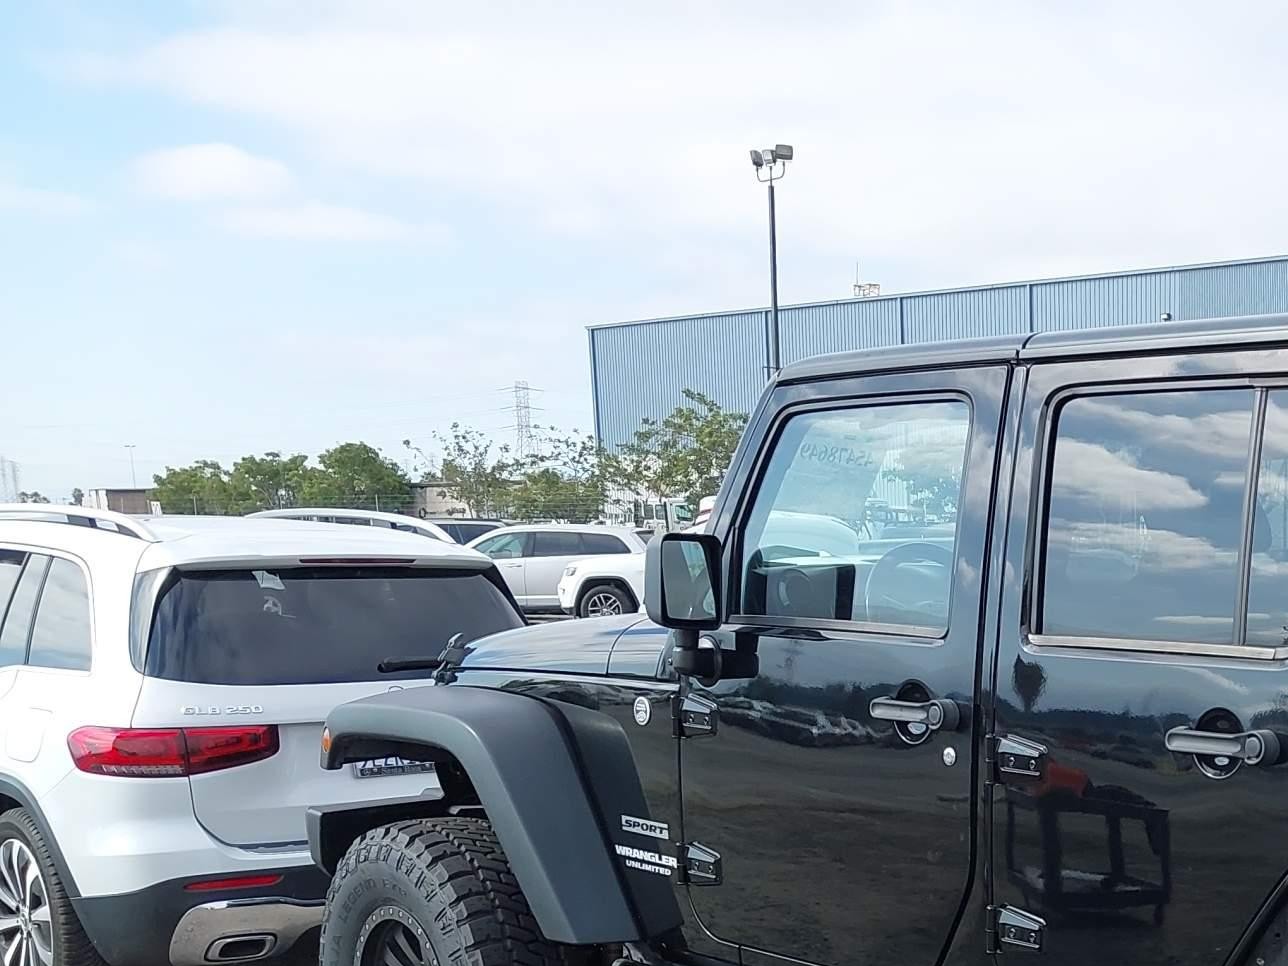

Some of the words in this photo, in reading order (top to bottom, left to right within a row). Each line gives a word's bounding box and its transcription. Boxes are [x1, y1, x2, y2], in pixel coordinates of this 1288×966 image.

[181, 705, 221, 716] GLB
[225, 704, 264, 715] 250
[624, 818, 665, 835] SPORT
[614, 844, 678, 869] WRANGLER
[625, 859, 672, 876] UNLIMITED
